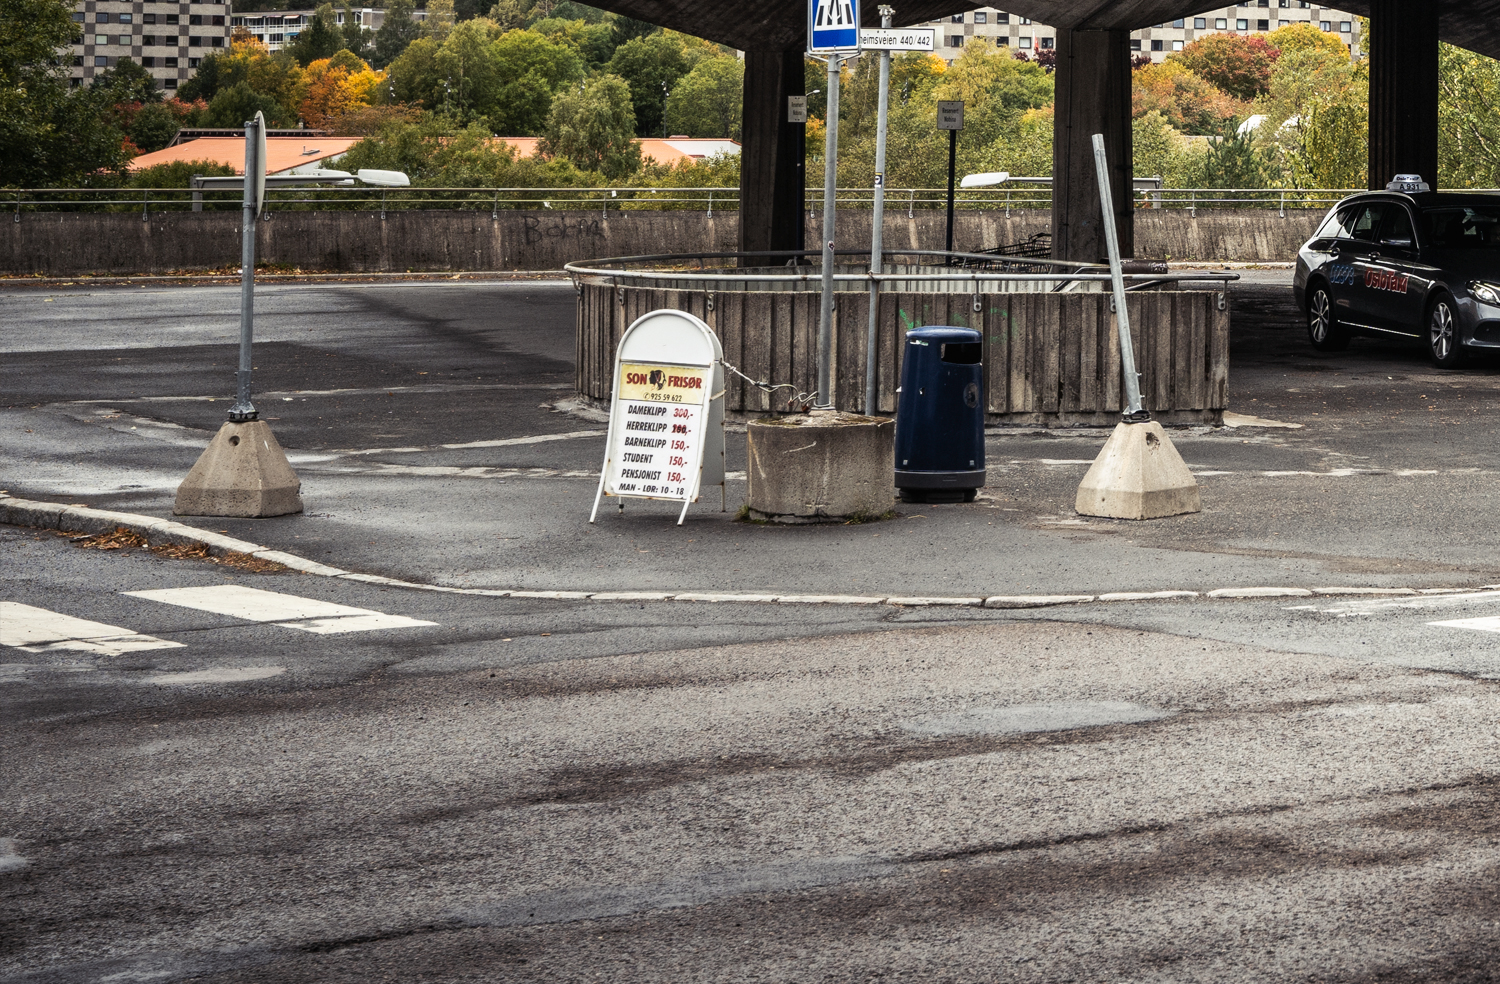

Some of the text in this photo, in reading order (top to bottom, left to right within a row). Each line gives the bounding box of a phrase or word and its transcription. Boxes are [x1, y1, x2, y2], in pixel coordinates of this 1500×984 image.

[899, 34, 931, 46] 440/442
[1406, 183, 1420, 191] 931
[626, 372, 702, 389] SON FRISØR
[651, 393, 661, 401] 925
[628, 405, 667, 416] DAMEKLIPP
[626, 420, 668, 432] HERREKLIPP
[624, 437, 690, 452] BARNEKLIPP 150,-
[623, 453, 688, 468] STUDENT 150,-
[621, 469, 686, 484] PENSJONIST 150,-
[619, 483, 636, 491] MAN
